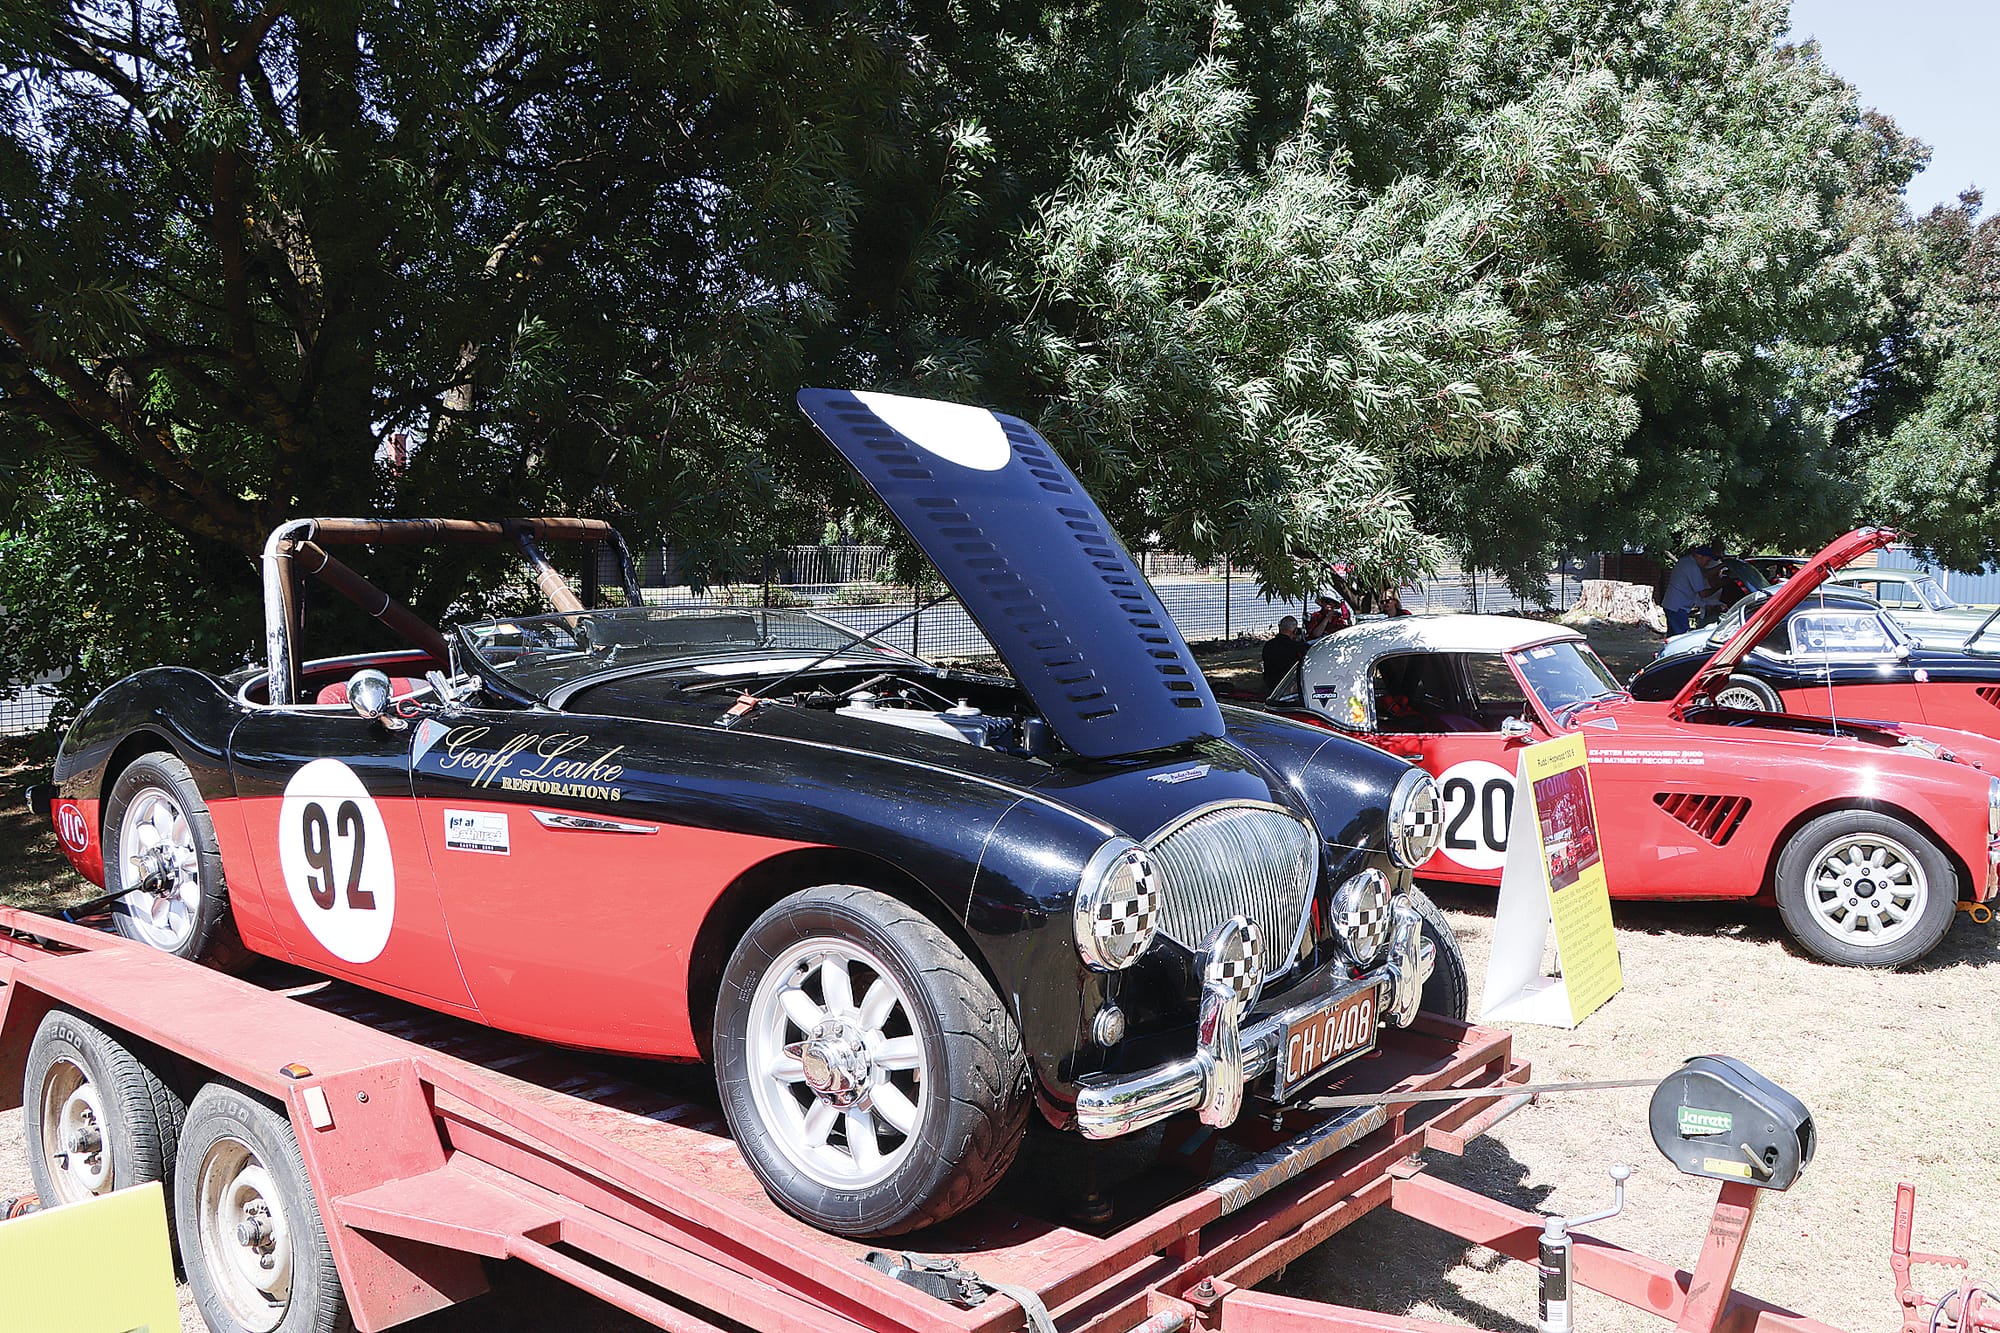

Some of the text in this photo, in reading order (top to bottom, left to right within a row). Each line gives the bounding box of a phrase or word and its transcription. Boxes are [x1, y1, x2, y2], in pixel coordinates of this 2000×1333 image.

[440, 726, 540, 788] Geoff
[520, 733, 625, 782] Leake
[501, 777, 621, 801] RESTORATIONS
[61, 811, 85, 845] VIC
[450, 817, 474, 829] 1st at
[1443, 777, 1514, 852] 20
[302, 800, 376, 910] 92
[50, 1025, 83, 1049] 2000
[732, 1087, 776, 1168] YOKOHAMA
[1680, 1110, 1731, 1129] Jarrett
